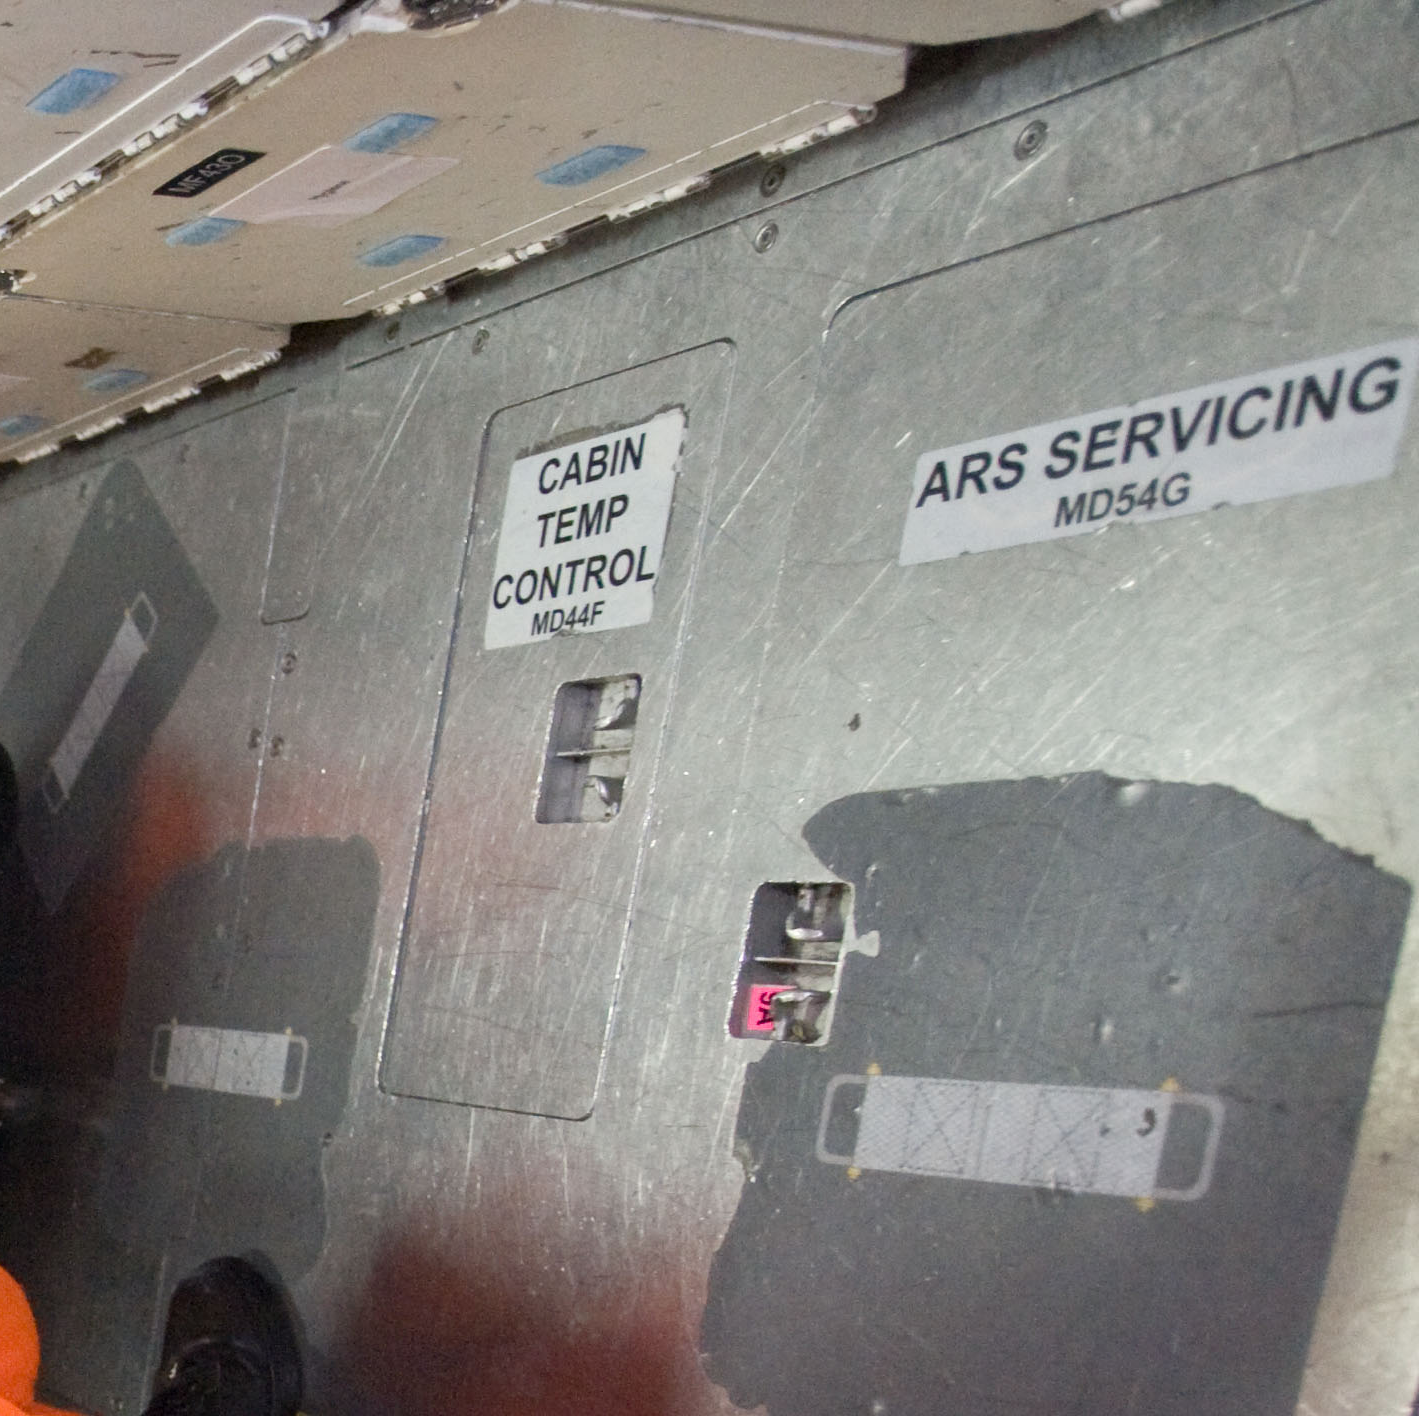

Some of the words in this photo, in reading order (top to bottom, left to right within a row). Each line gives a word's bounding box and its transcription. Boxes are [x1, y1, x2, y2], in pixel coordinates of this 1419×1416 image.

[916, 443, 1028, 507] ARS
[1045, 357, 1403, 480] SERVICING
[539, 433, 647, 495] CABIN
[538, 494, 630, 548] TEMP
[1054, 472, 1193, 528] MD54G
[493, 546, 656, 610] CONTROL
[531, 602, 606, 636] MD44F
